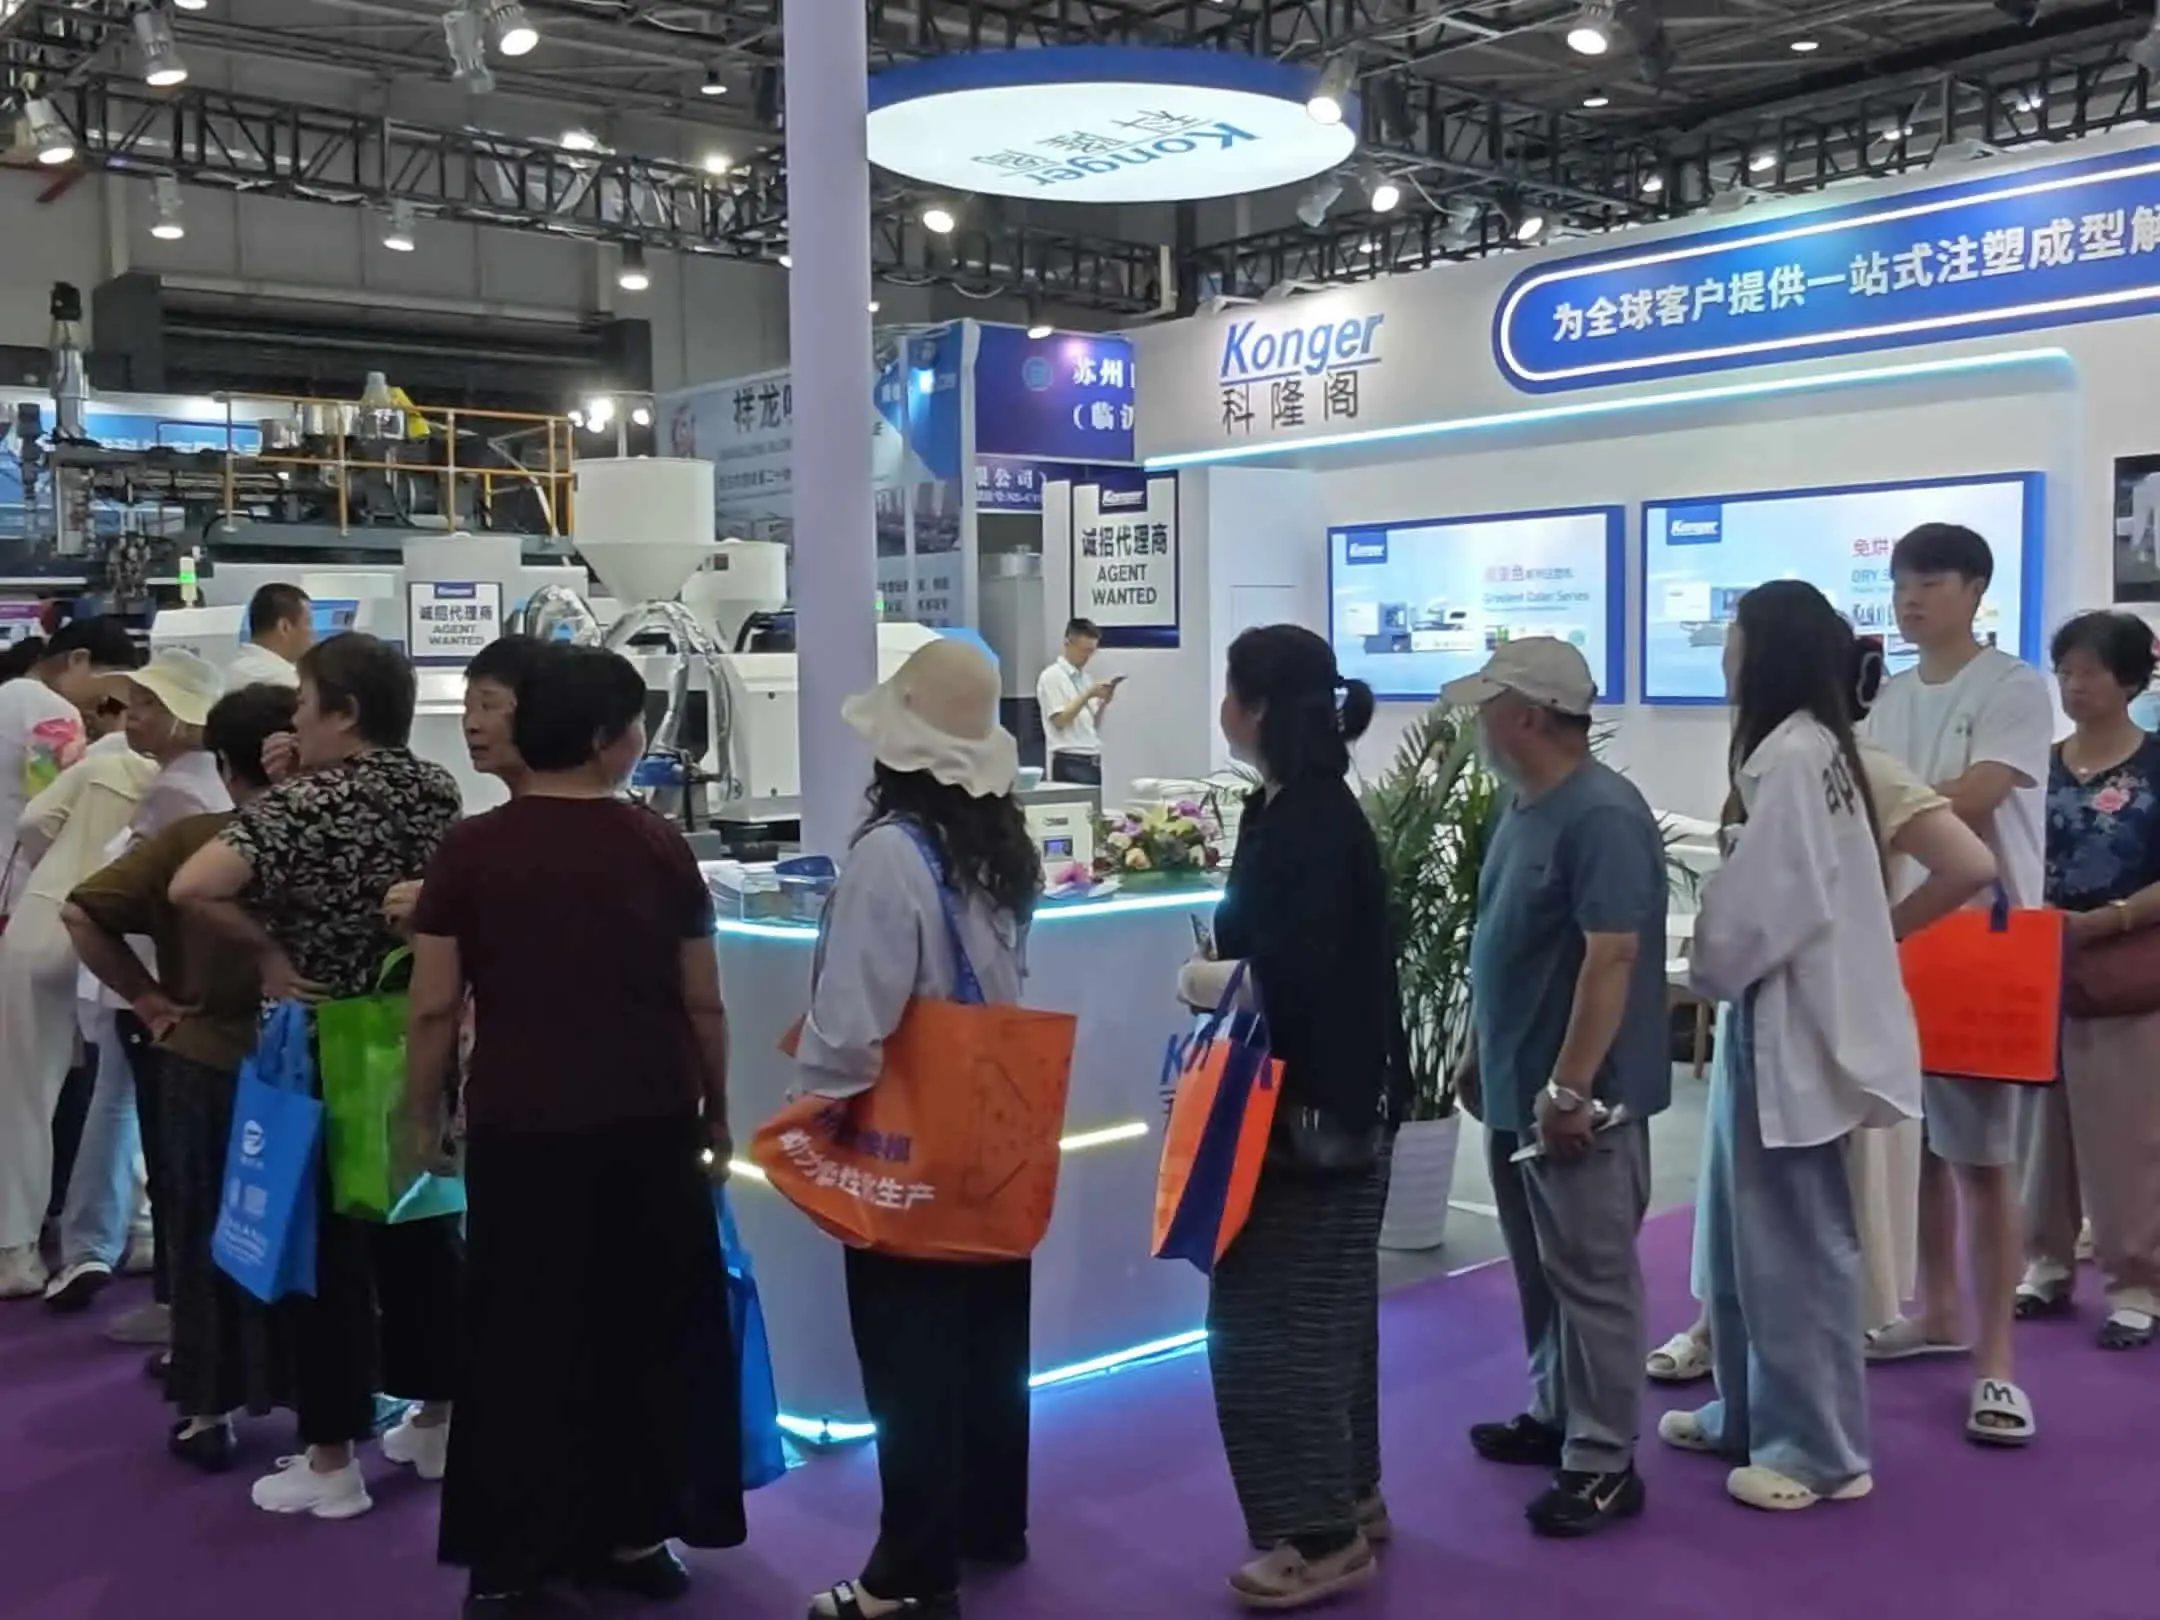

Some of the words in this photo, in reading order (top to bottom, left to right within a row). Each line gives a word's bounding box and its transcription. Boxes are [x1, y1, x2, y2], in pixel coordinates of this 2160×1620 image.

[1024, 122, 1260, 186] Konger
[1221, 314, 1385, 376] Konger
[1072, 356, 1135, 388] 苏州
[1222, 370, 1359, 436] 科隆阁
[1082, 523, 1168, 557] 诚招代理商
[1097, 563, 1148, 582] AGENT
[1091, 587, 1158, 607] WANTED
[428, 635, 485, 646] WANTED
[431, 624, 476, 634] AGENT
